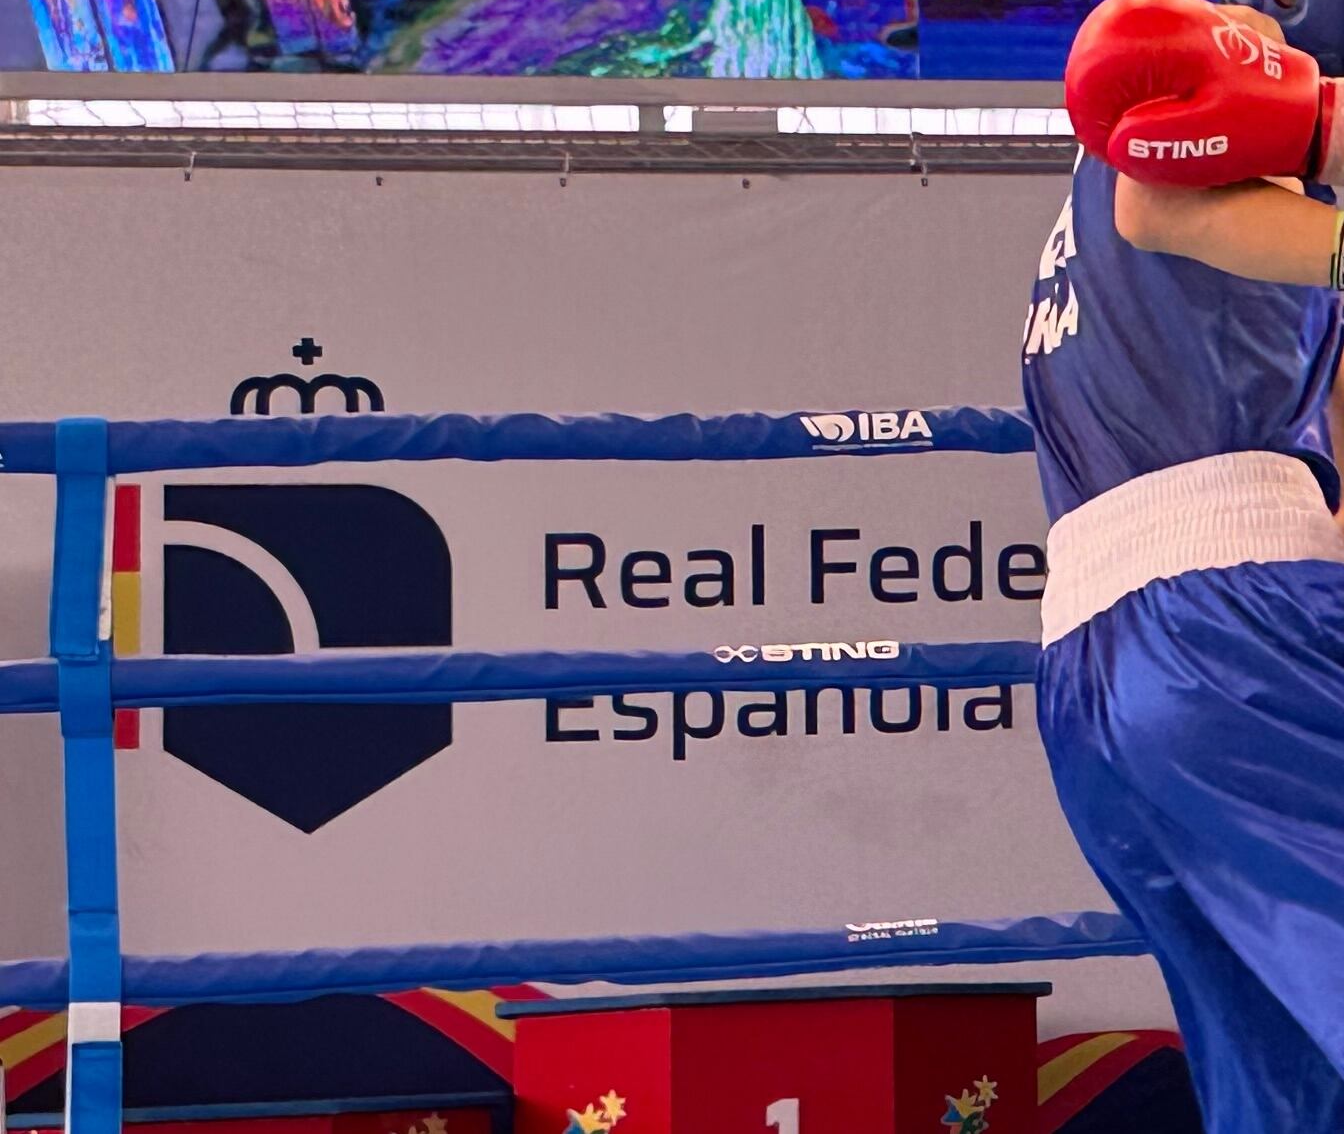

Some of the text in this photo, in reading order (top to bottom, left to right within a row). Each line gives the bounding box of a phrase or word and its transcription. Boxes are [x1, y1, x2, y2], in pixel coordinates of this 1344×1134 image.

[1128, 135, 1228, 160] STING
[859, 411, 932, 441] IBA
[545, 520, 1048, 610] Real Fede
[760, 640, 899, 662] STING
